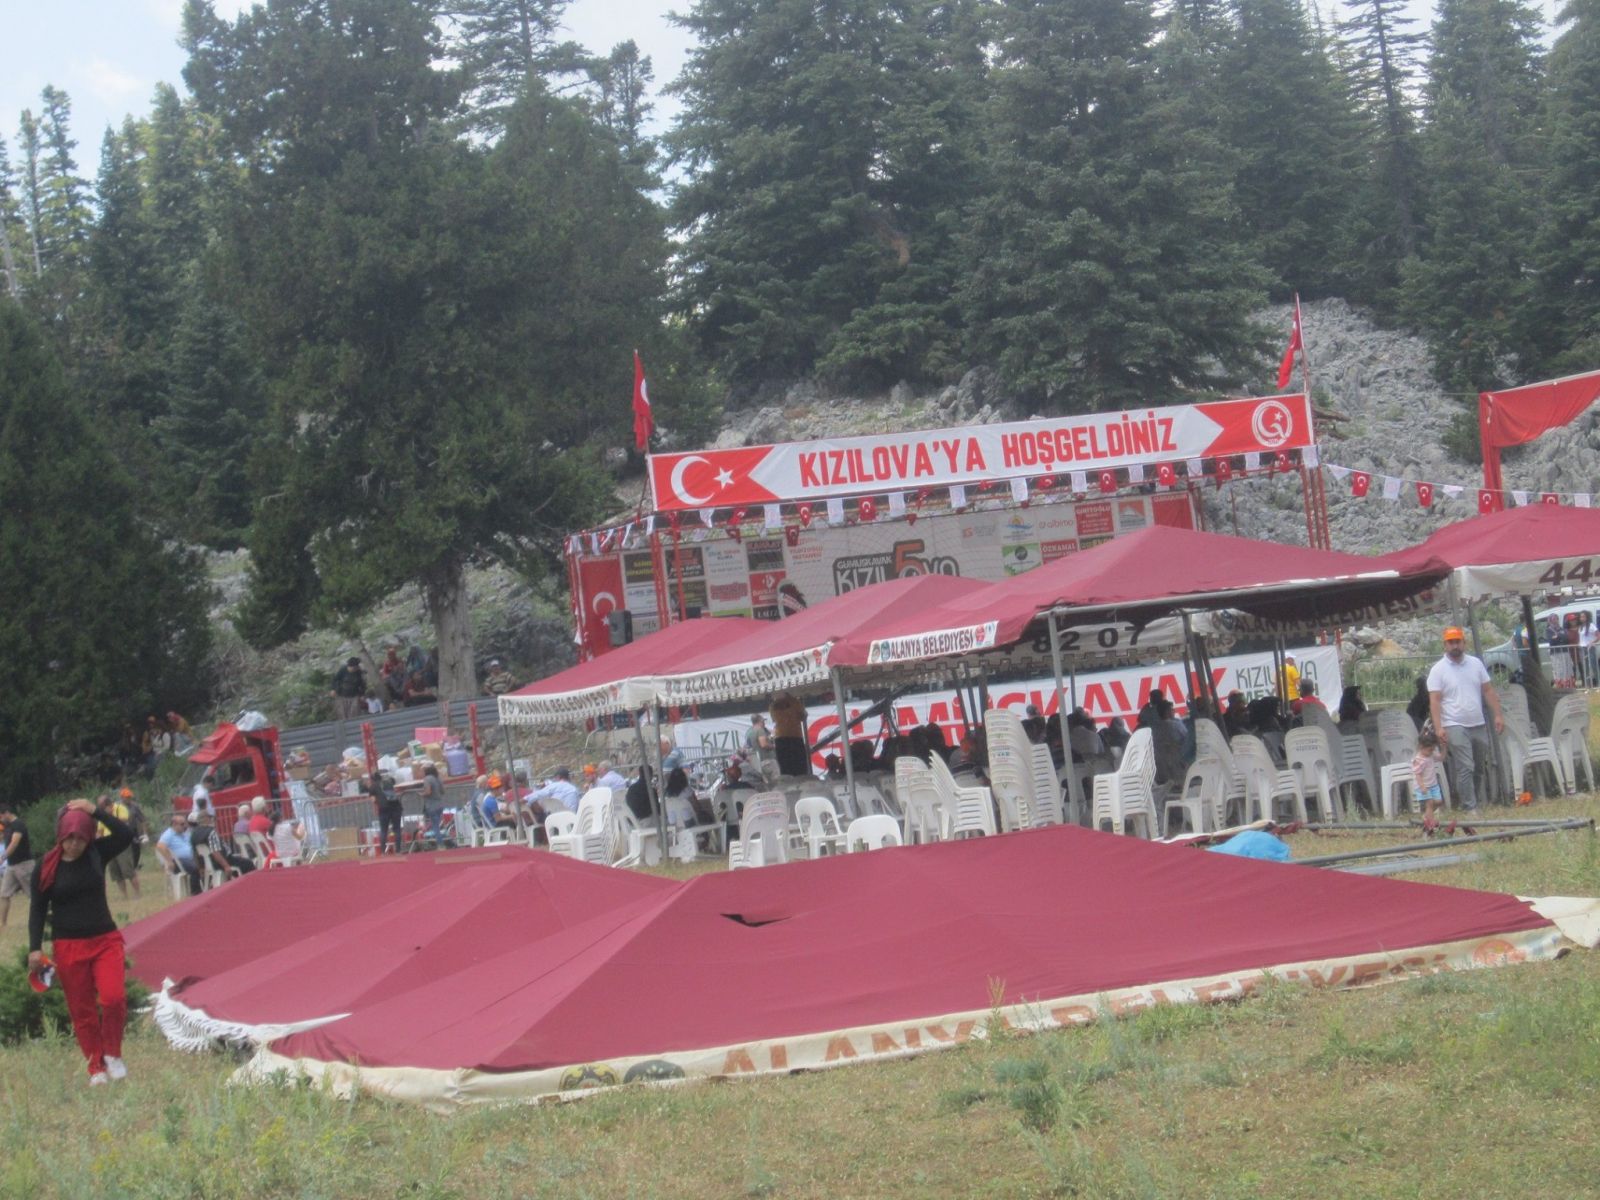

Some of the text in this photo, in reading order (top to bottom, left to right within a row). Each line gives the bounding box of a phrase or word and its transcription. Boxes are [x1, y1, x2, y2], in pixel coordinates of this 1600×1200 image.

[798, 410, 1178, 488] KIZILOVA'YA HOŞGELDİNİZ
[1538, 558, 1600, 586] 44
[890, 640, 922, 659] ALANYA
[685, 673, 730, 693] ALANYA
